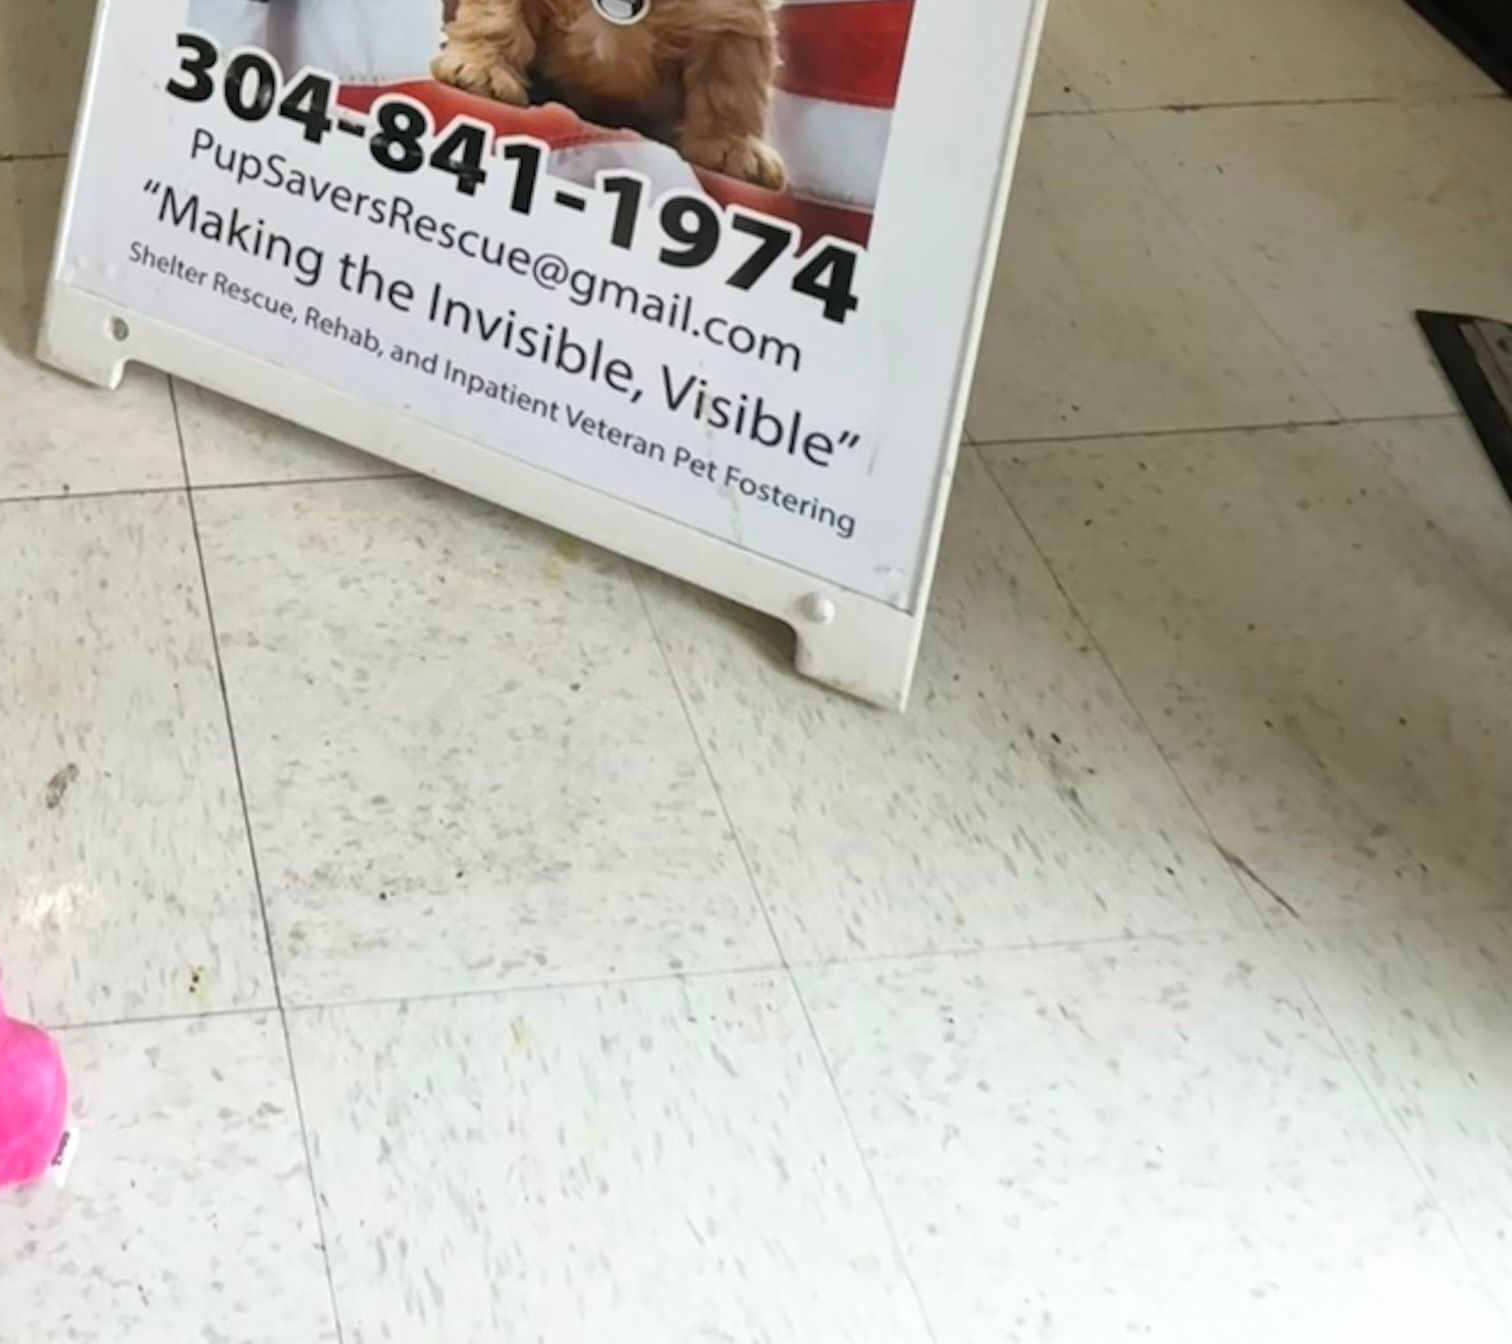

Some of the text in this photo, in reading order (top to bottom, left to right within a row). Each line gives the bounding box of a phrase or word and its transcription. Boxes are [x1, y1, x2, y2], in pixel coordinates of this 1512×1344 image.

[142, 178, 859, 466] “Making the Invisible, Visible”
[167, 35, 857, 322] 304-841-1974
[192, 129, 800, 371] PupSaversRescue@gmail.com
[129, 240, 855, 539] Shelter Rescue, Rehab, and Inpatient Veteran Pet Fostering
